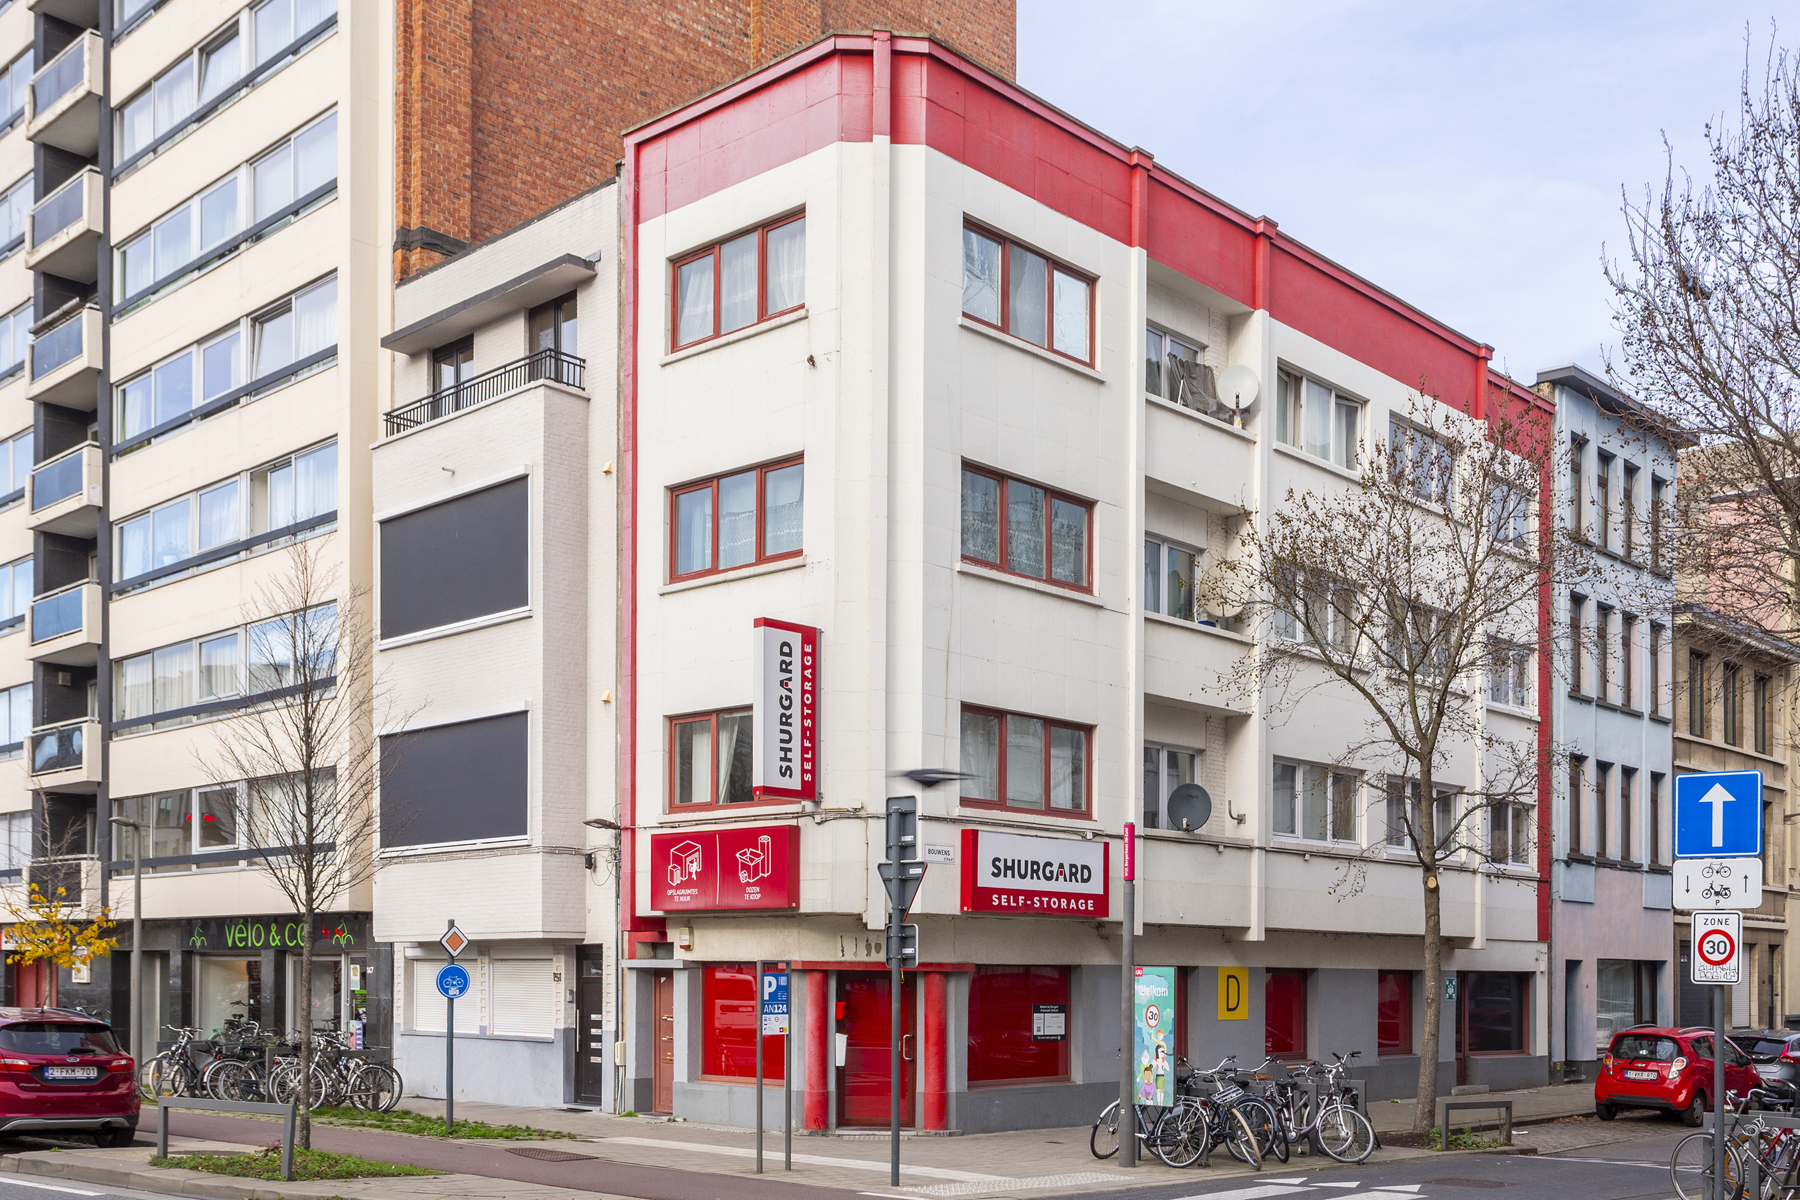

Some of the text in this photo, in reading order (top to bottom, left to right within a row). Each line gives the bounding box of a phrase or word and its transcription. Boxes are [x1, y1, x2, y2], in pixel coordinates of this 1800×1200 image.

[779, 640, 793, 780] SHURGARD
[803, 643, 812, 782] SELF-STORAGE
[927, 848, 951, 856] BOUWENS
[991, 856, 1092, 884] SHURGARD
[992, 894, 1094, 911] SELF-STORAGE
[1703, 918, 1730, 926] ZONE
[225, 918, 265, 948] vélo
[269, 923, 281, 947] &
[1705, 940, 1727, 955] 30
[763, 976, 777, 1000] P
[1138, 984, 1169, 997] Welkom
[1226, 974, 1240, 1012] D
[763, 1004, 787, 1013] AN124
[1148, 1010, 1159, 1021] 30
[50, 1067, 96, 1076] 2-FKM-701
